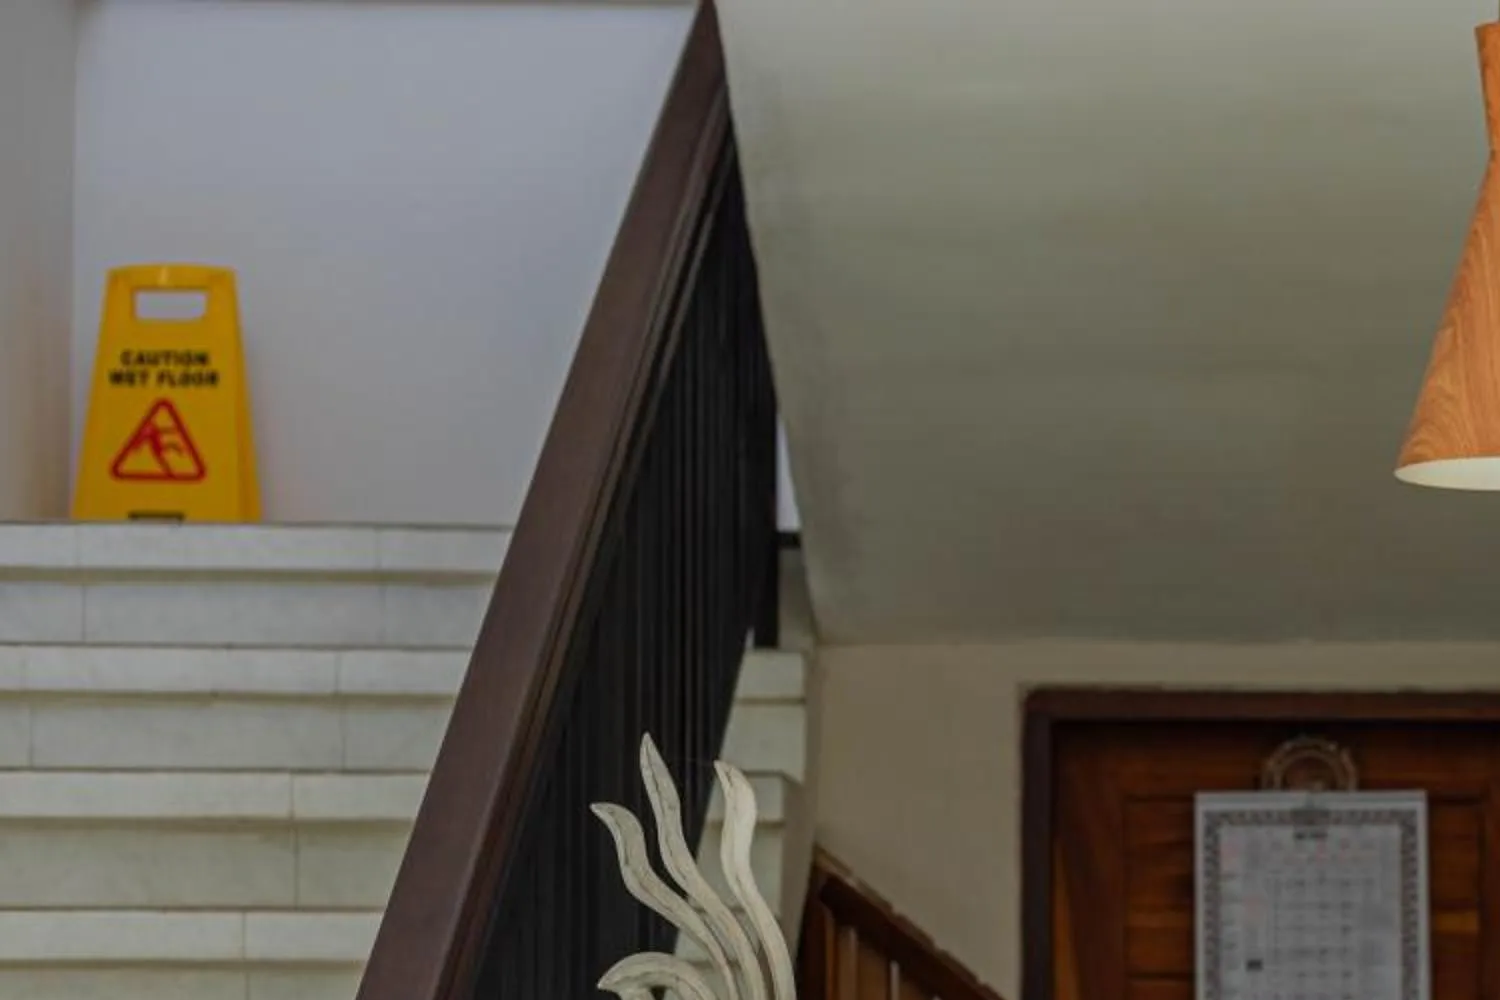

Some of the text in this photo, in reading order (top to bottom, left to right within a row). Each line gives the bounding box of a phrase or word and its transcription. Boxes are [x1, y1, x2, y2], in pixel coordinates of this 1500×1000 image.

[120, 351, 209, 366] CAUTION
[109, 371, 220, 387] WET FLOOR
